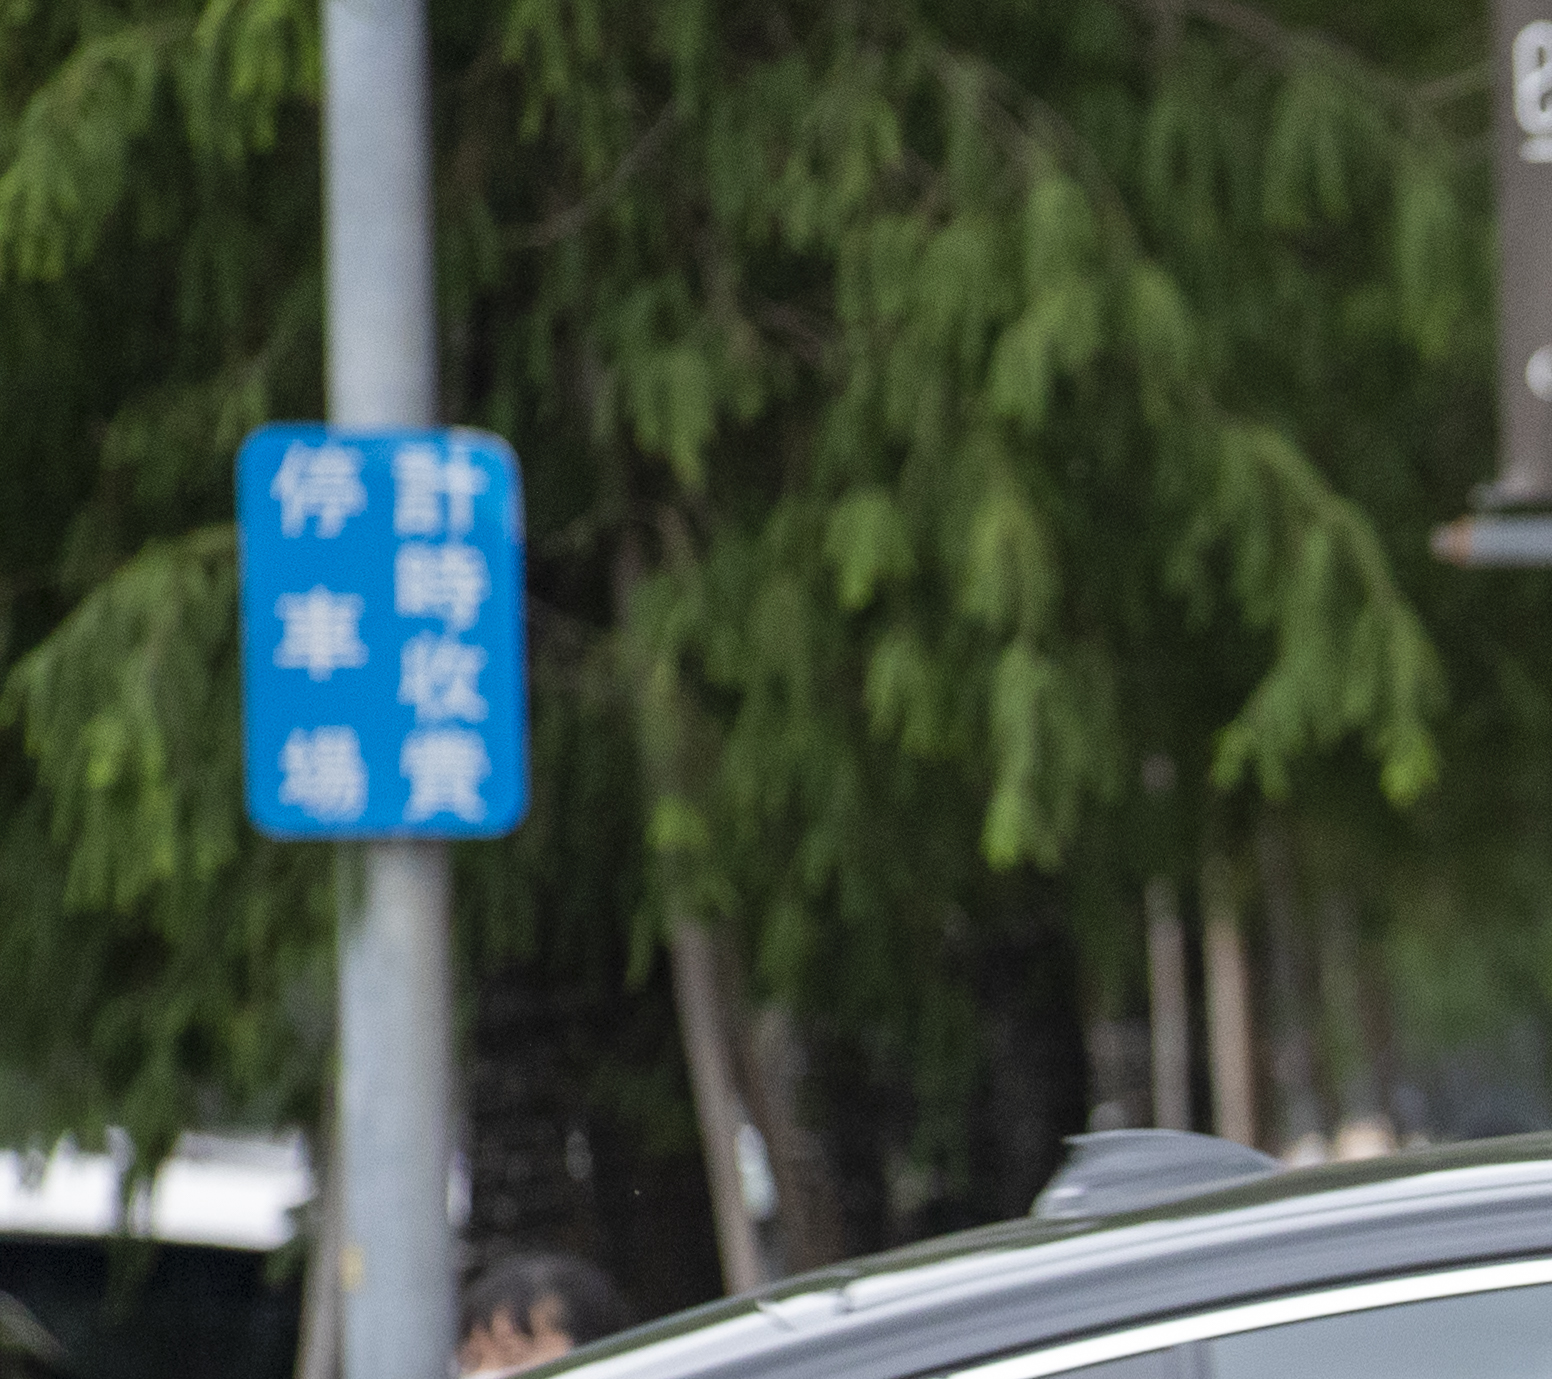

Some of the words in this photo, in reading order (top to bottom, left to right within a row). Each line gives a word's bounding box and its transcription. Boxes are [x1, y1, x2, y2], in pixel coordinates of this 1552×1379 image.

[270, 440, 369, 822] 停車場
[394, 438, 490, 822] 計時收費
